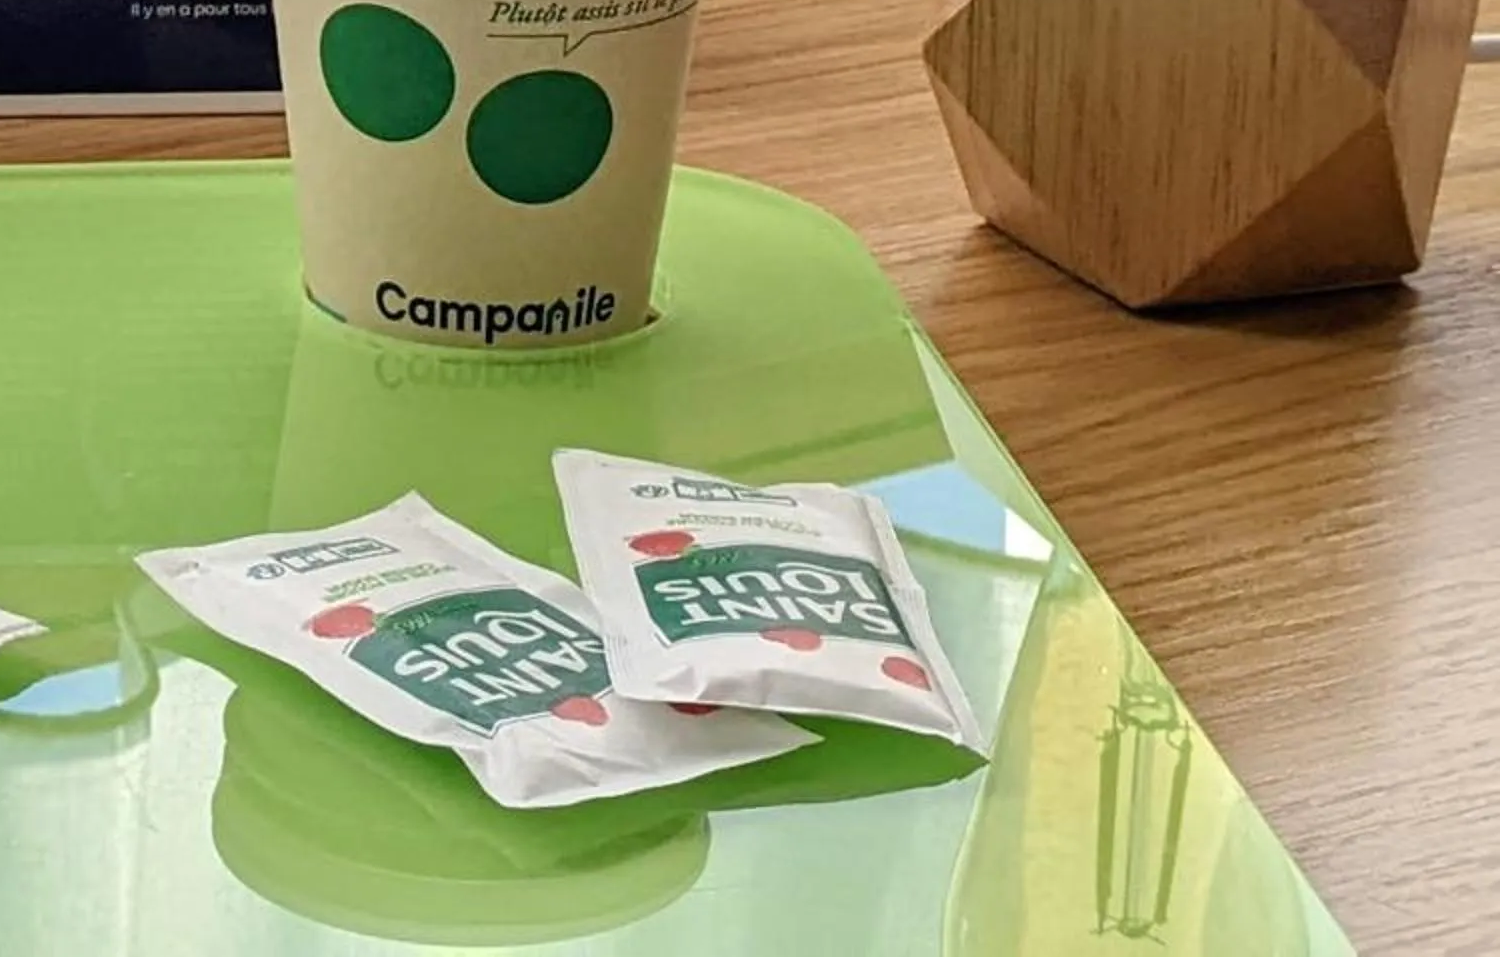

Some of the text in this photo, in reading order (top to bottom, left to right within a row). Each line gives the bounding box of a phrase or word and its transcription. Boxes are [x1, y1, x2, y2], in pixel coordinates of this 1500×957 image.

[193, 2, 266, 18] pour tous
[489, 0, 569, 25] Plutôt
[375, 280, 616, 345] Campanile
[653, 561, 878, 602] LOUIS
[680, 595, 901, 636] SAINT
[393, 608, 581, 683] LOUIS
